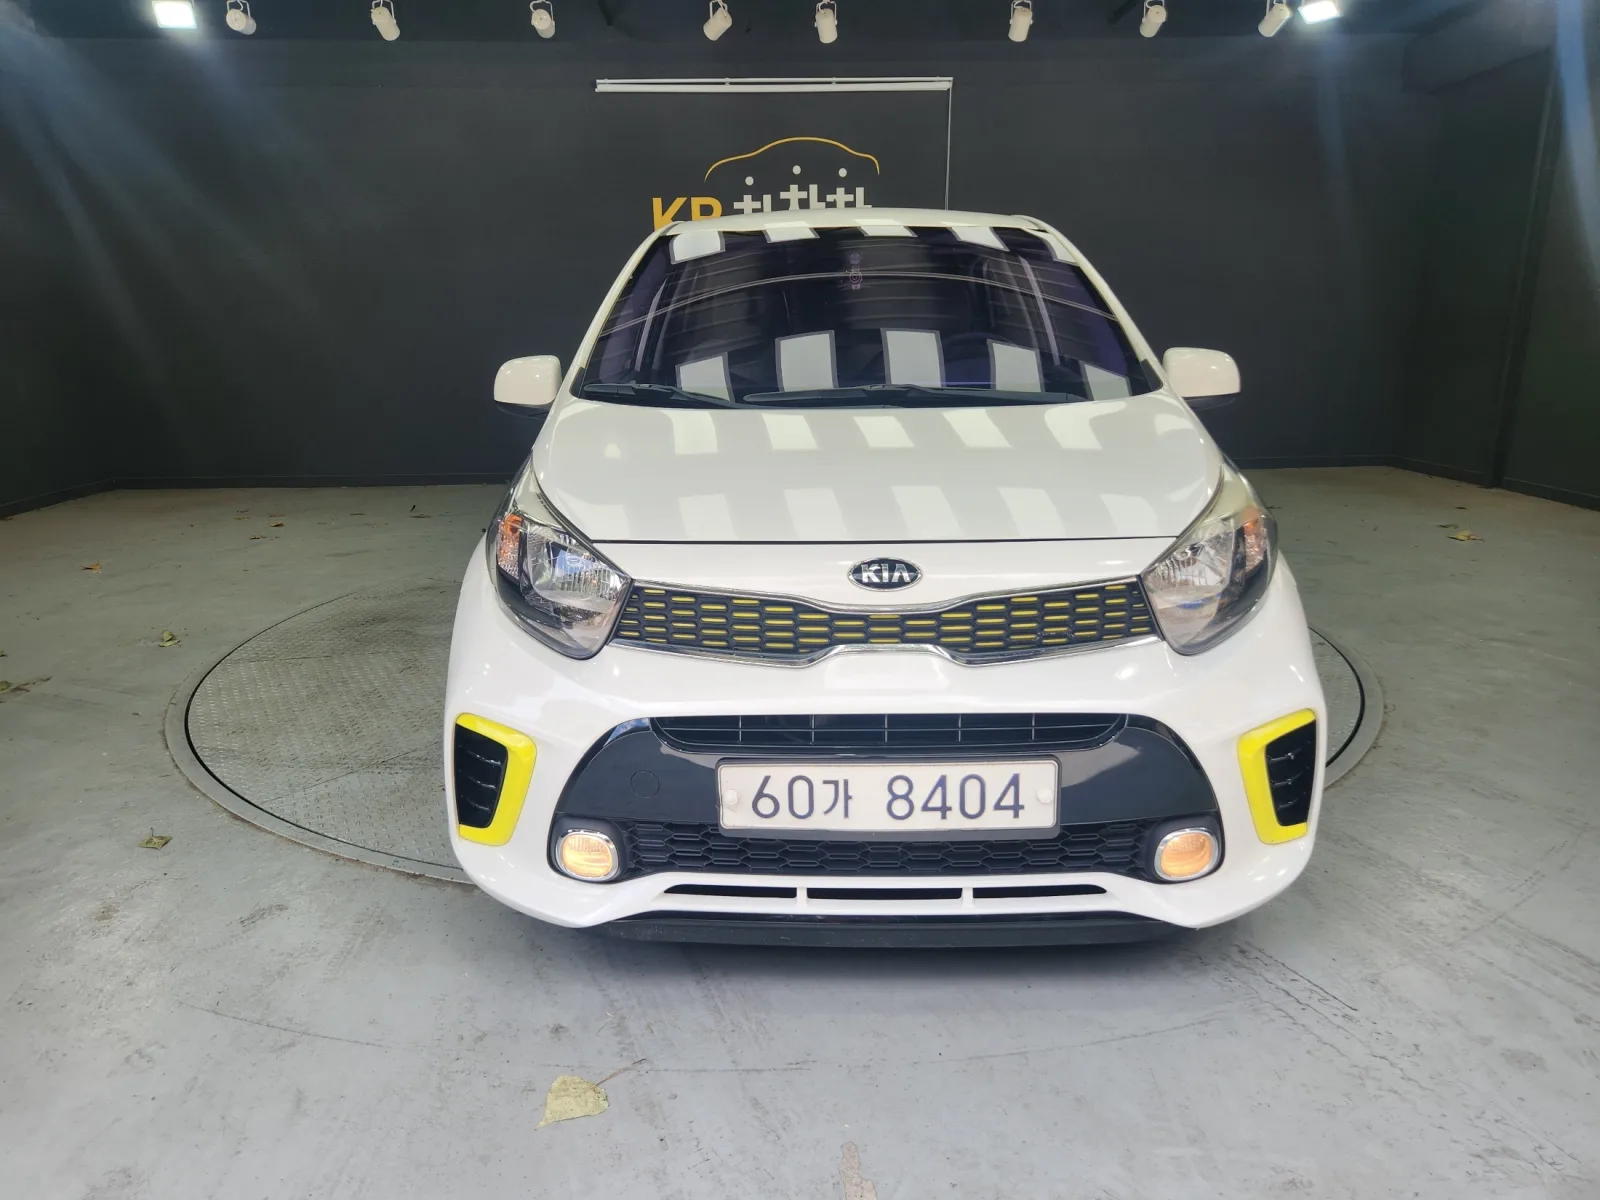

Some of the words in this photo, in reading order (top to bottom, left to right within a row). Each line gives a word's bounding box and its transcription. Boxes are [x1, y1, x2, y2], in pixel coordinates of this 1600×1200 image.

[861, 563, 911, 583] KIA
[751, 774, 853, 820] 60가
[886, 773, 1025, 821] 8404
